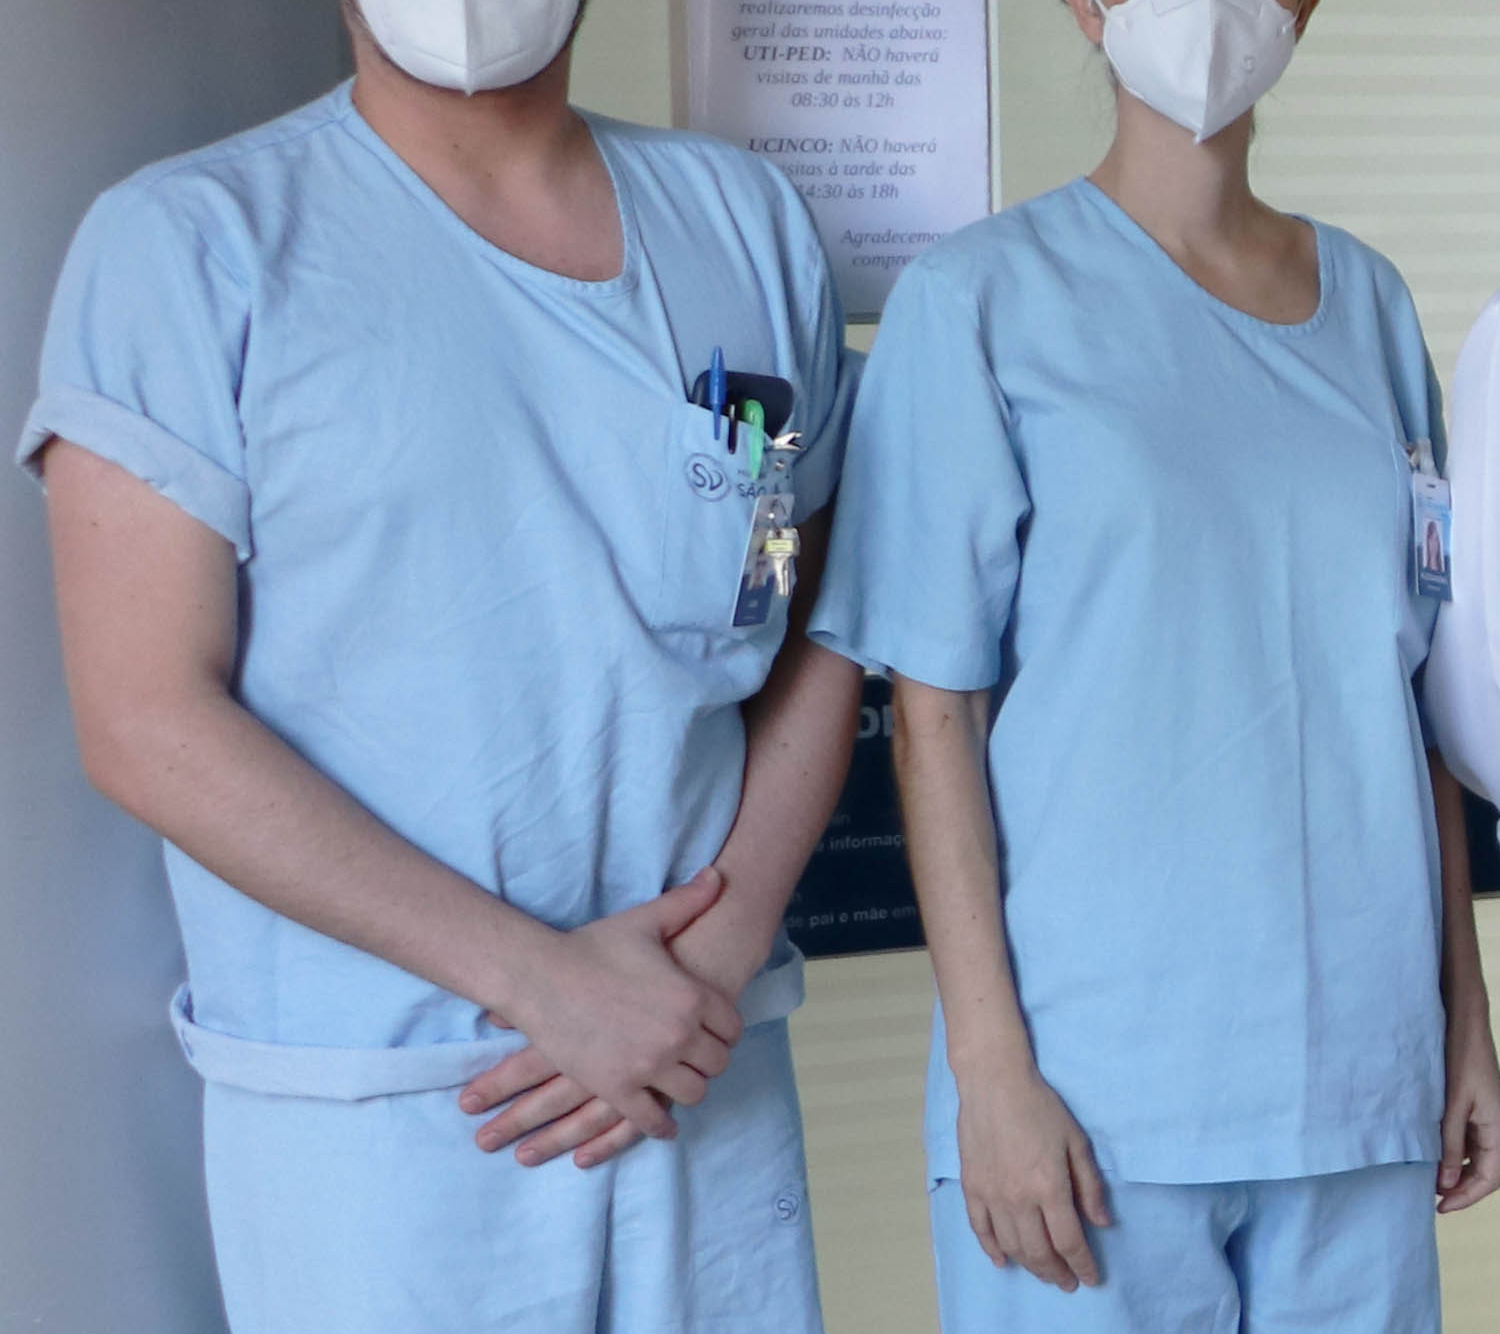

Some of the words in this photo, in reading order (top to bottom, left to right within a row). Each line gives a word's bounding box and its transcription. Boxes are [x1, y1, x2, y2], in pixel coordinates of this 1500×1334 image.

[739, 0, 844, 17] realizaremos
[848, 2, 941, 21] desinfecção
[731, 22, 775, 42] geral
[781, 23, 809, 38] das
[813, 23, 884, 40] unidades
[888, 24, 948, 41] abaixo:
[744, 45, 832, 62] UTI-PED:
[842, 42, 881, 62] NÃO
[886, 46, 940, 63] haverá
[757, 69, 809, 85] visitas
[814, 69, 833, 85] de
[838, 69, 890, 85] manhã
[894, 69, 922, 86] das
[791, 91, 839, 108] 08:30
[867, 91, 895, 108] 12h
[749, 137, 833, 155] UCINCO:
[839, 134, 879, 154] NÃO
[883, 137, 937, 155] haverá
[843, 161, 883, 177] tarde
[888, 161, 917, 177] das
[871, 183, 899, 200] 18h
